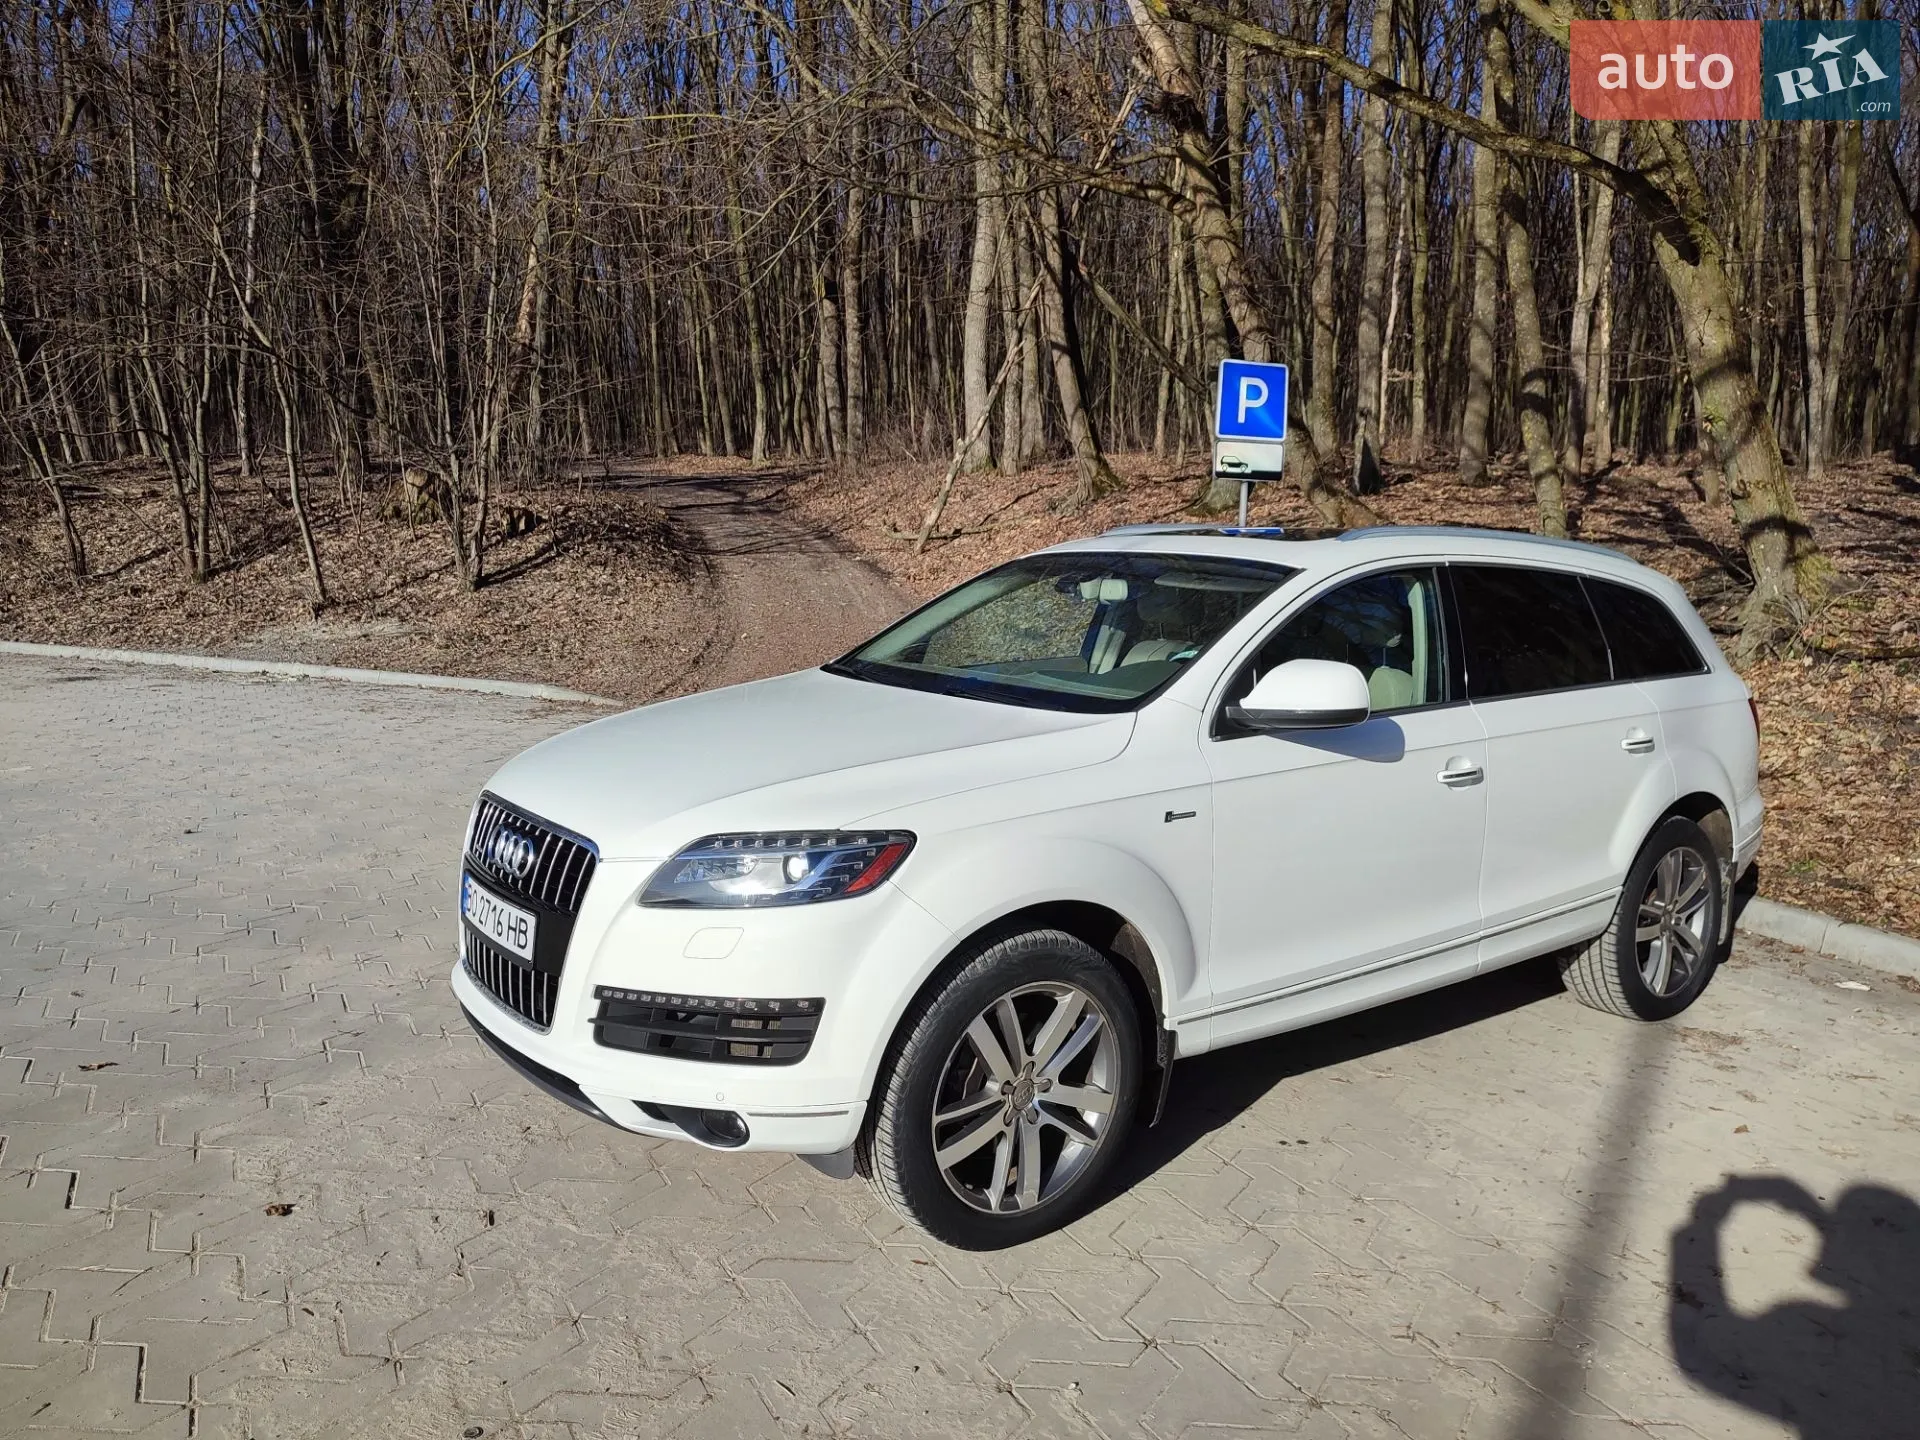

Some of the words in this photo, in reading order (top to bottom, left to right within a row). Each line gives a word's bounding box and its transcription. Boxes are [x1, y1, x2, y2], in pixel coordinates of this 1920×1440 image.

[1237, 376, 1269, 424] P
[478, 895, 505, 938] 2716
[506, 911, 529, 950] HB
